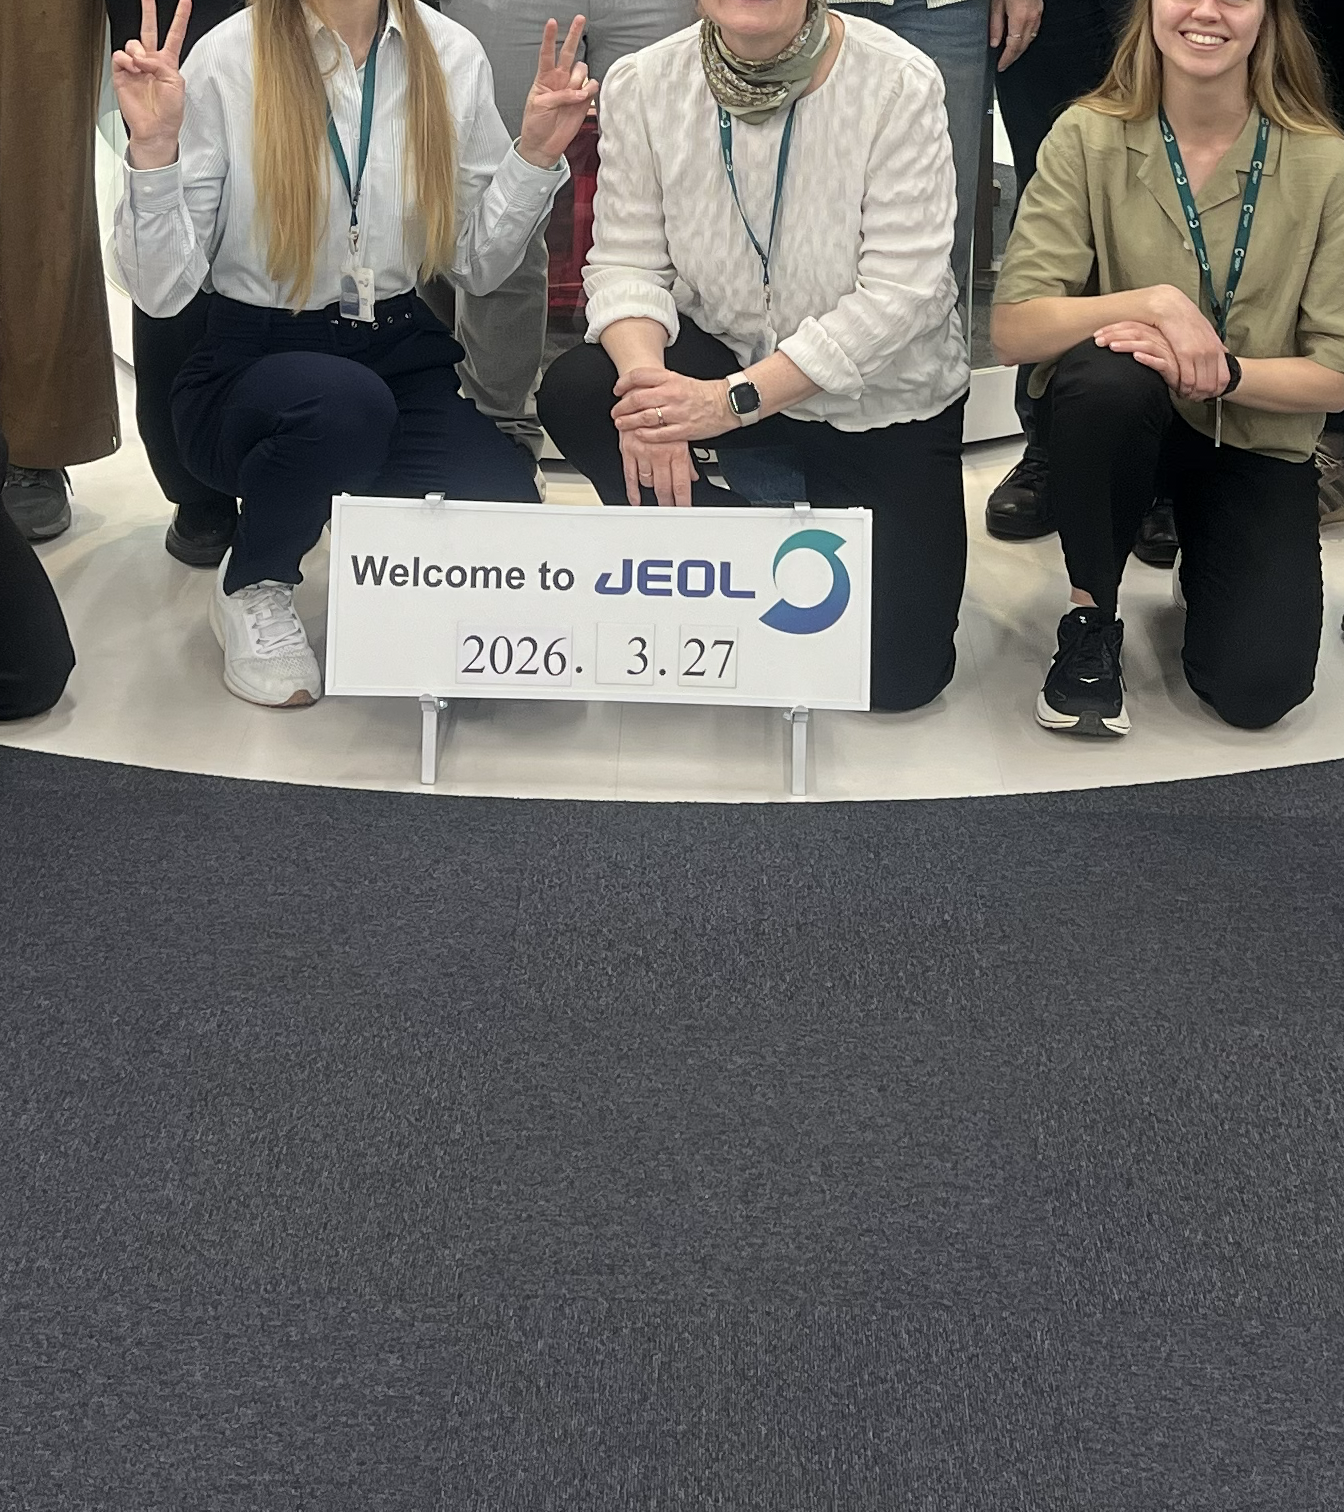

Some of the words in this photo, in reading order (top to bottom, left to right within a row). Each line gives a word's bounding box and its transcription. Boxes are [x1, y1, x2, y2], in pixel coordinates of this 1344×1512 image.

[351, 554, 526, 590] Welcome
[538, 560, 575, 591] to
[594, 558, 756, 599] JEOL
